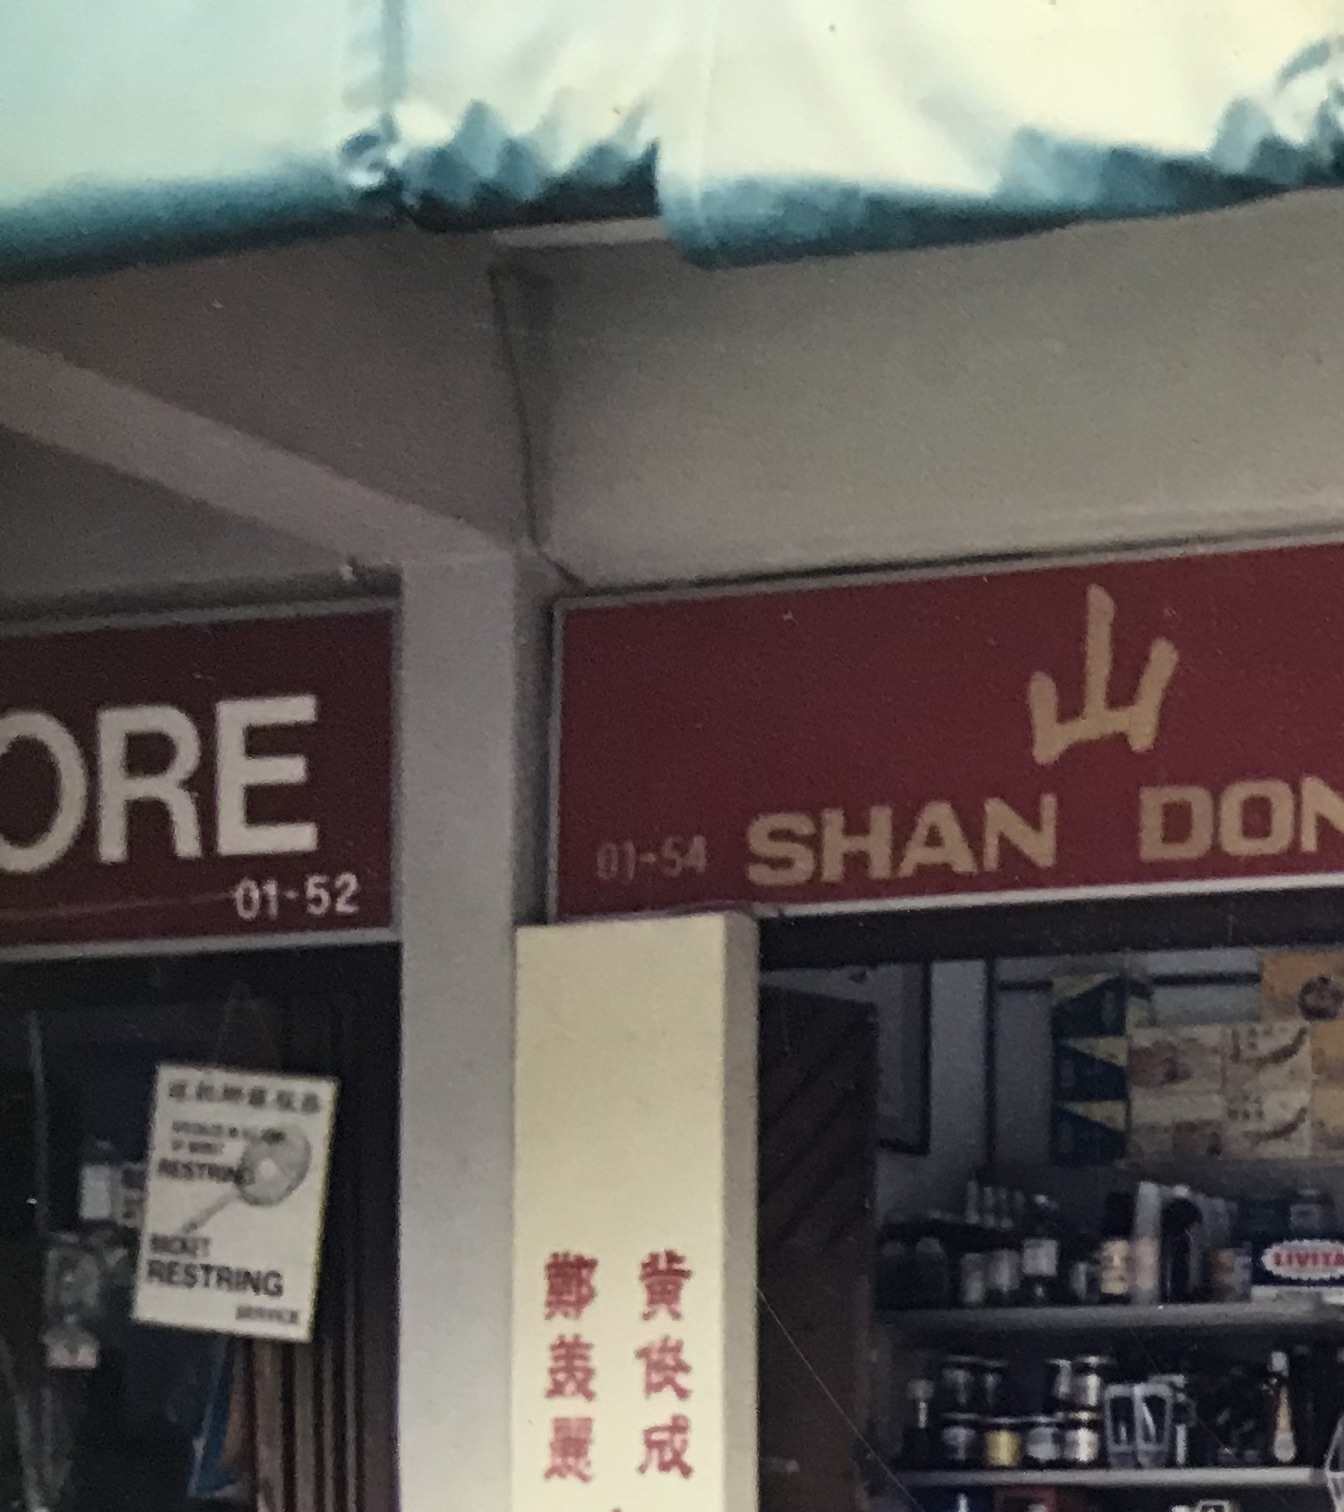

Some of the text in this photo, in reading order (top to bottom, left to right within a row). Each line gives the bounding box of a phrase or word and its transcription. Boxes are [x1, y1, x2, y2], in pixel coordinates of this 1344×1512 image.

[0, 694, 318, 874] ORE
[597, 833, 708, 883] 01-54
[747, 796, 1058, 887] SHAN
[232, 872, 361, 921] 01-52
[147, 1259, 283, 1298] RESTRING
